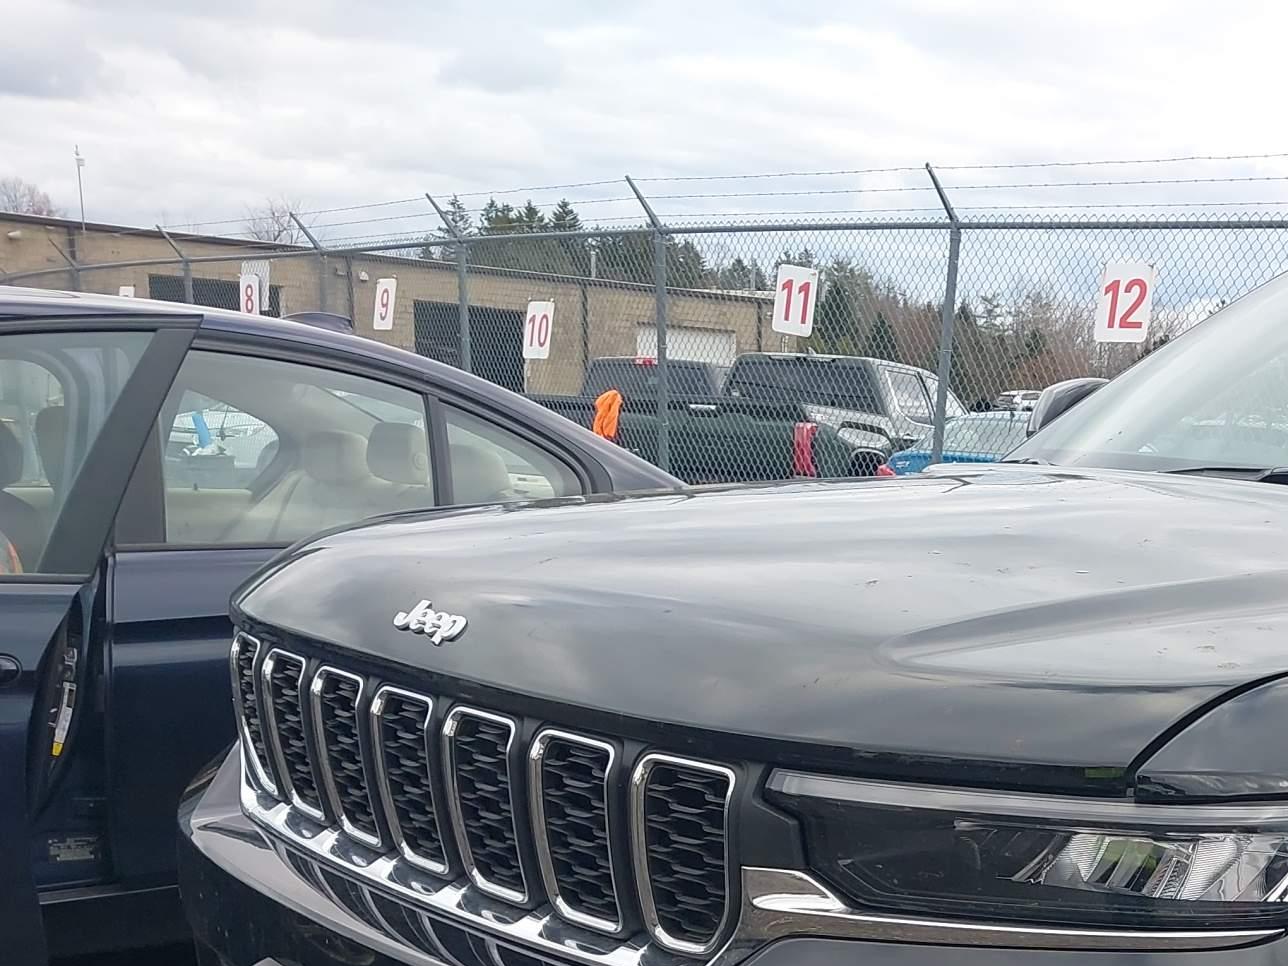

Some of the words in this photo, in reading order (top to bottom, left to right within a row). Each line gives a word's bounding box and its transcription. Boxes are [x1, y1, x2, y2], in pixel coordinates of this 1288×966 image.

[244, 284, 254, 313] 8
[379, 288, 390, 321] 9
[780, 278, 812, 325] 11
[1103, 279, 1148, 329] 12
[528, 313, 549, 348] 10
[393, 599, 468, 646] Jeep
